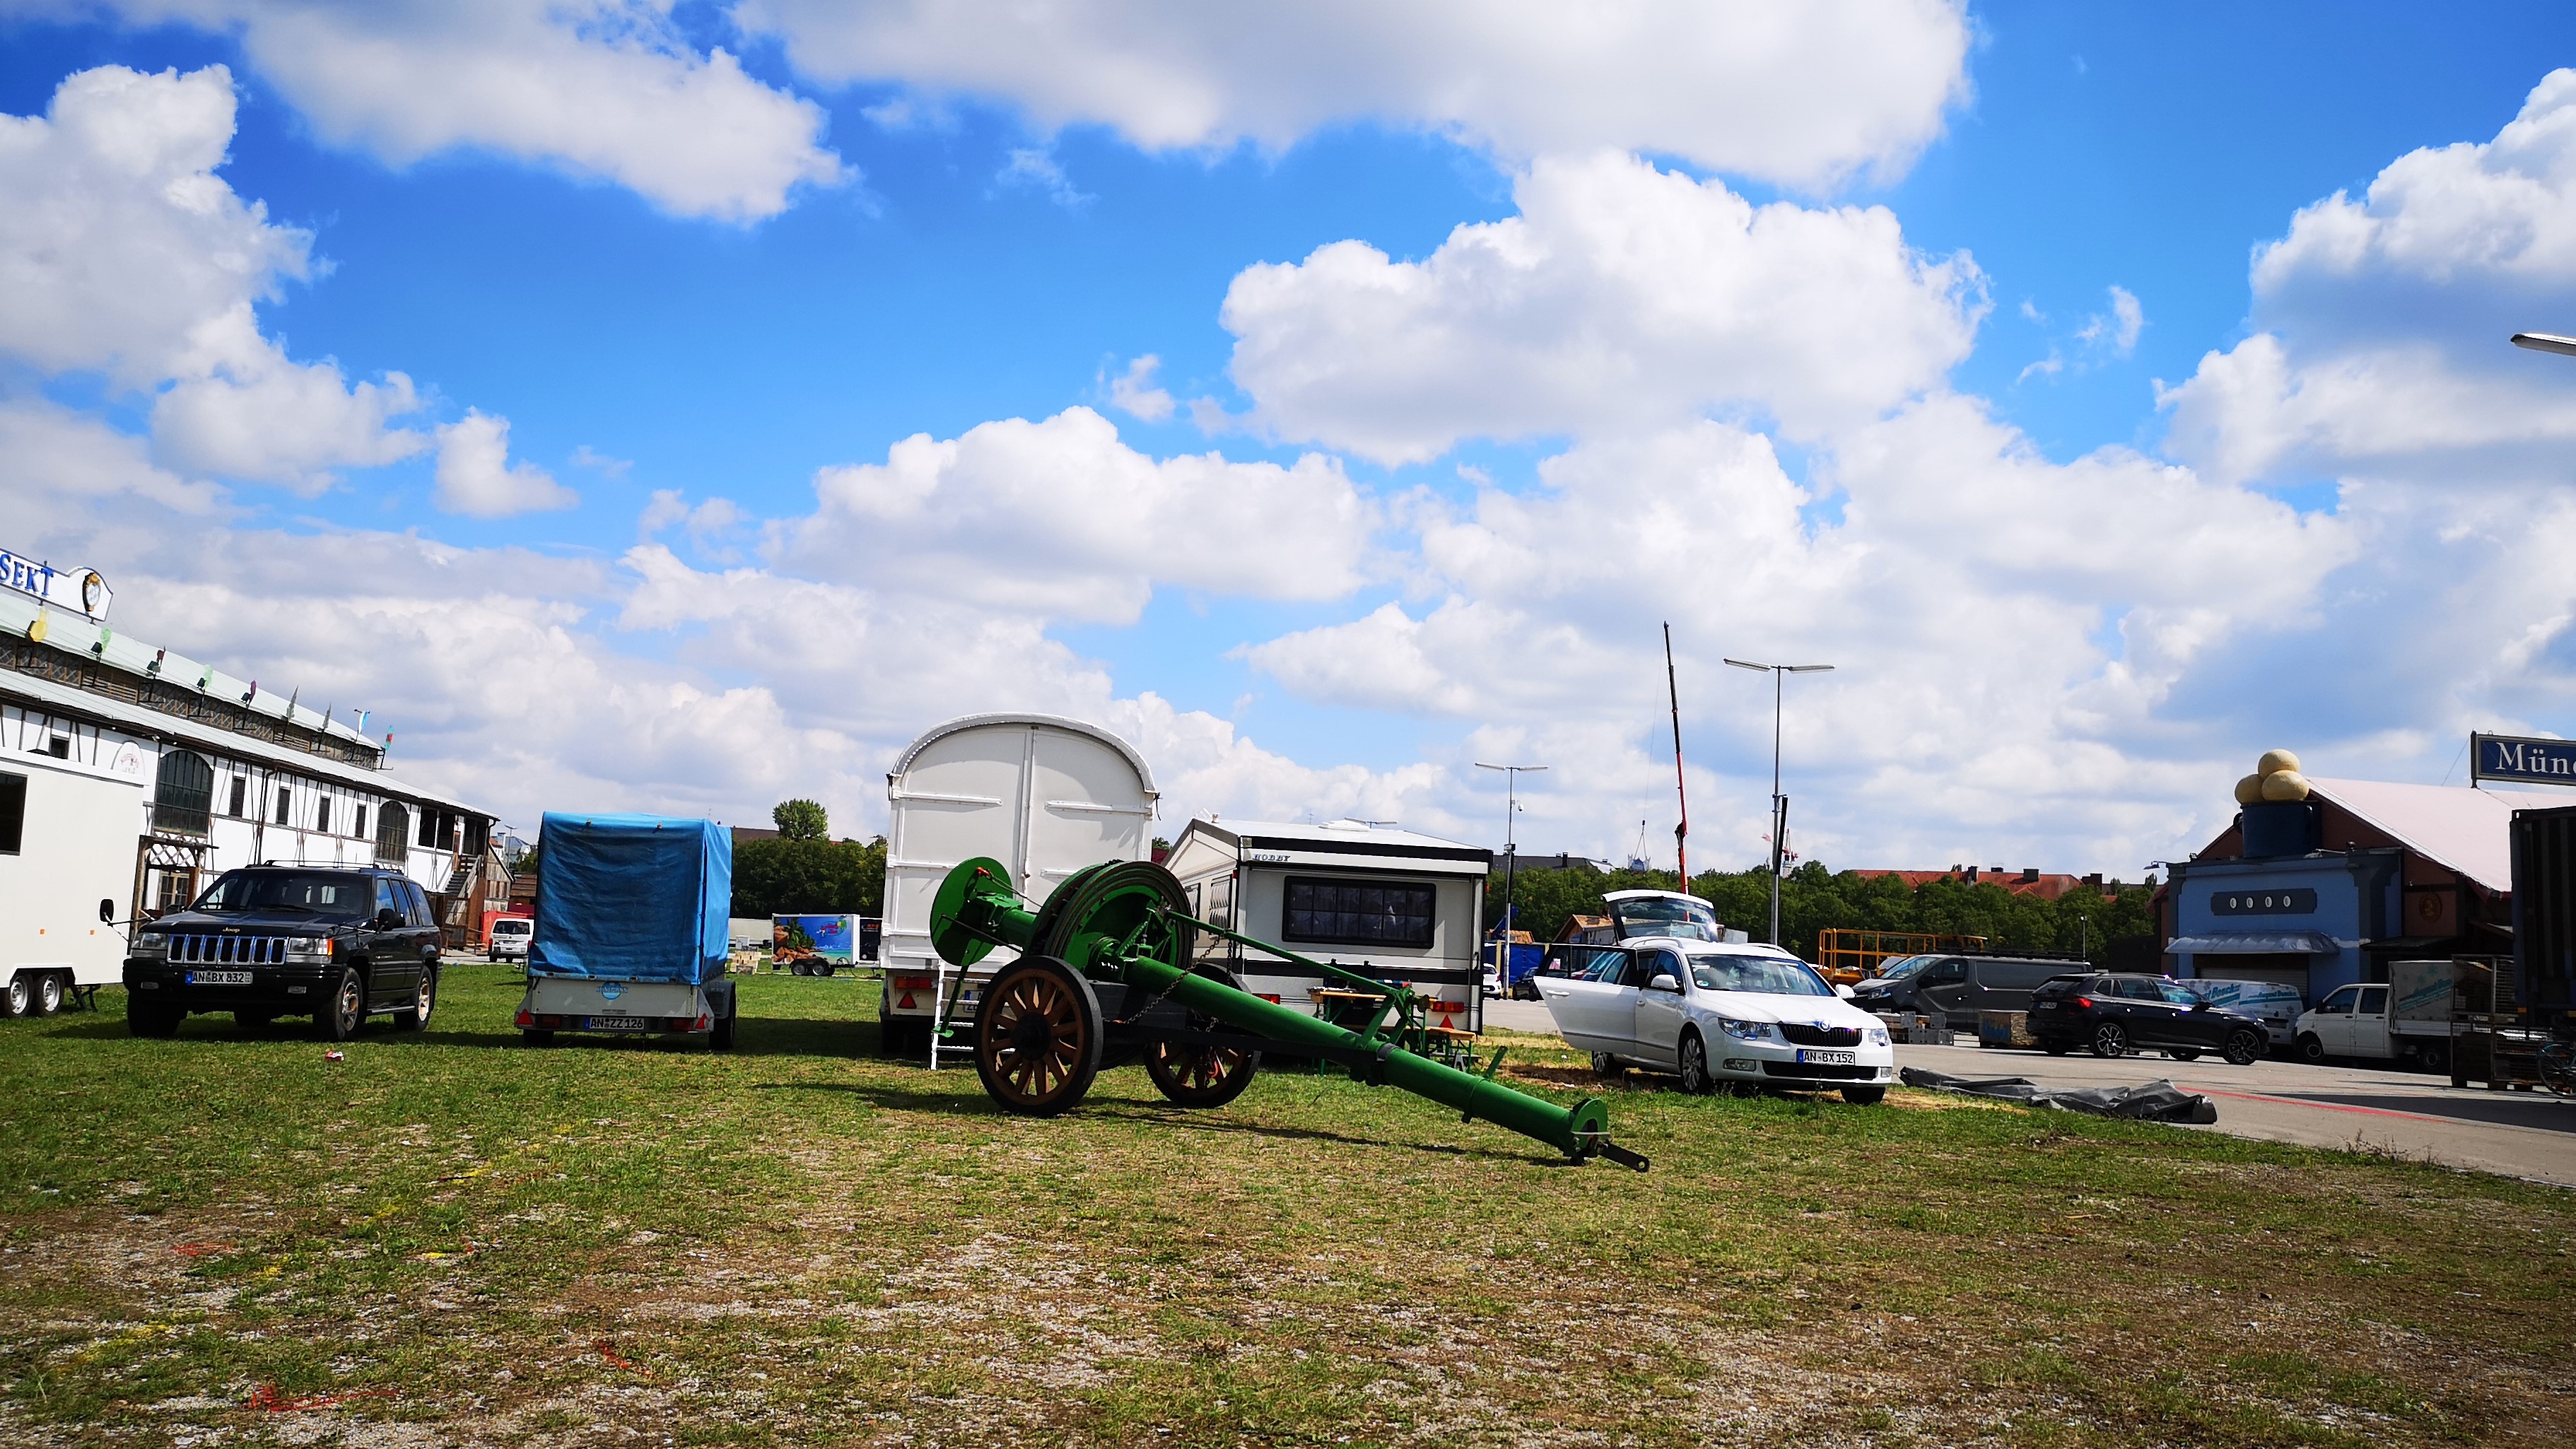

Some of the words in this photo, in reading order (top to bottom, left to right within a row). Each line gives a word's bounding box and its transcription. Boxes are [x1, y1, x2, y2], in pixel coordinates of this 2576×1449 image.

[0, 554, 54, 597] SEKT
[2495, 742, 2576, 775] Mün
[193, 972, 205, 982] AN
[211, 973, 224, 982] BX
[226, 973, 244, 982] 832
[590, 1019, 604, 1028] AN
[610, 1019, 623, 1028] ZZ
[625, 1019, 643, 1028] 126
[1804, 1052, 1816, 1062] AN
[1822, 1052, 1834, 1062] BX
[1837, 1054, 1853, 1063] 152
